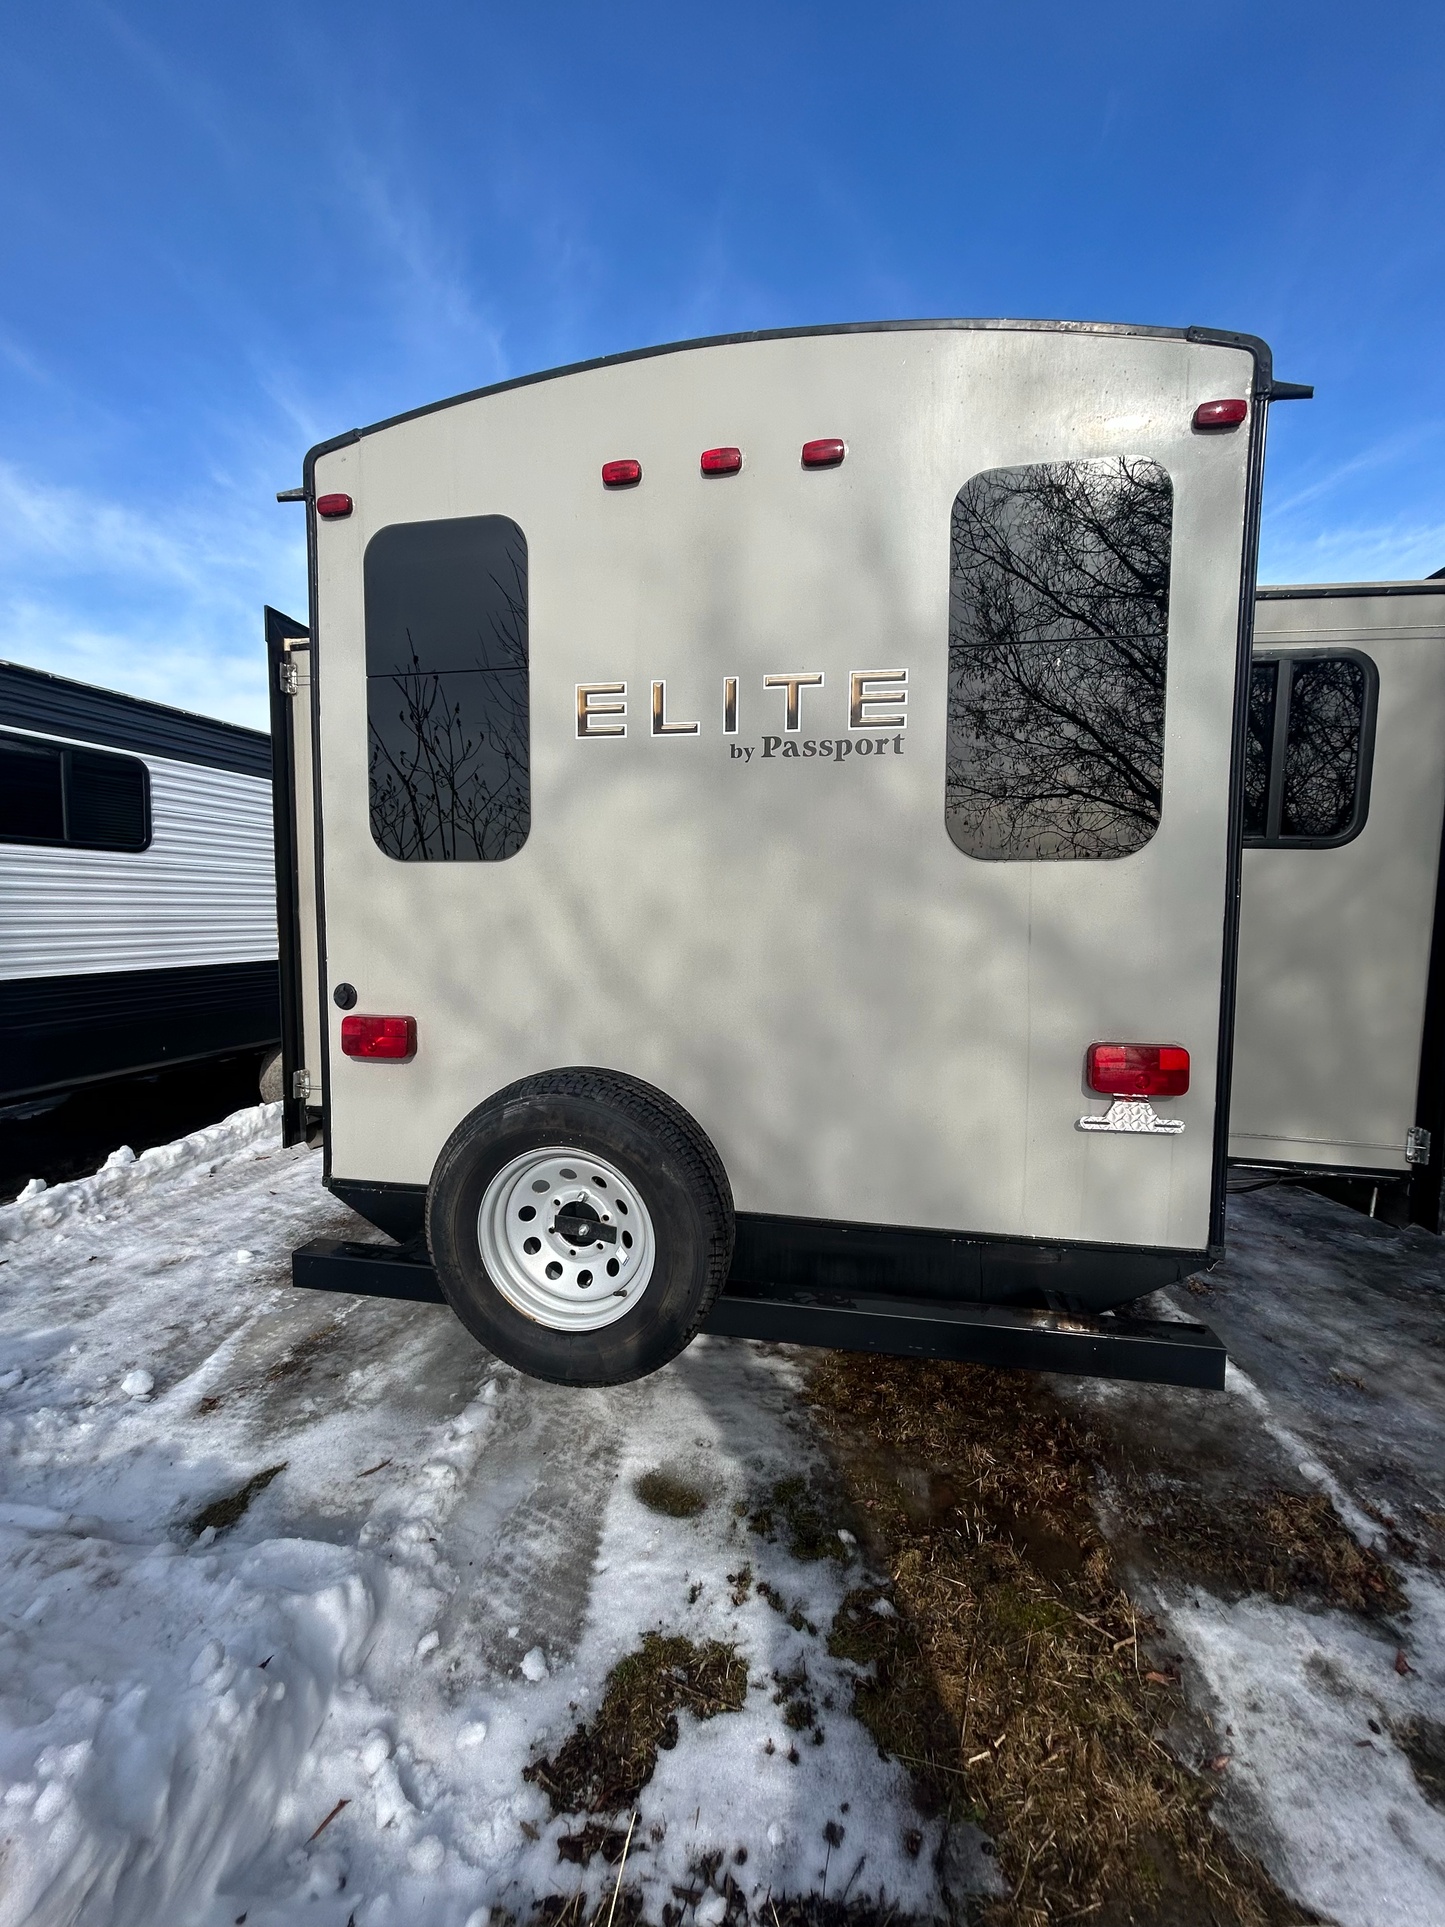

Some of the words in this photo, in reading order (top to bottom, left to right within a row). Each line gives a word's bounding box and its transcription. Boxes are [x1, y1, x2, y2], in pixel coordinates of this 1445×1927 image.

[575, 668, 908, 739] ELITE
[730, 744, 755, 763] by
[761, 734, 905, 762] Passport
